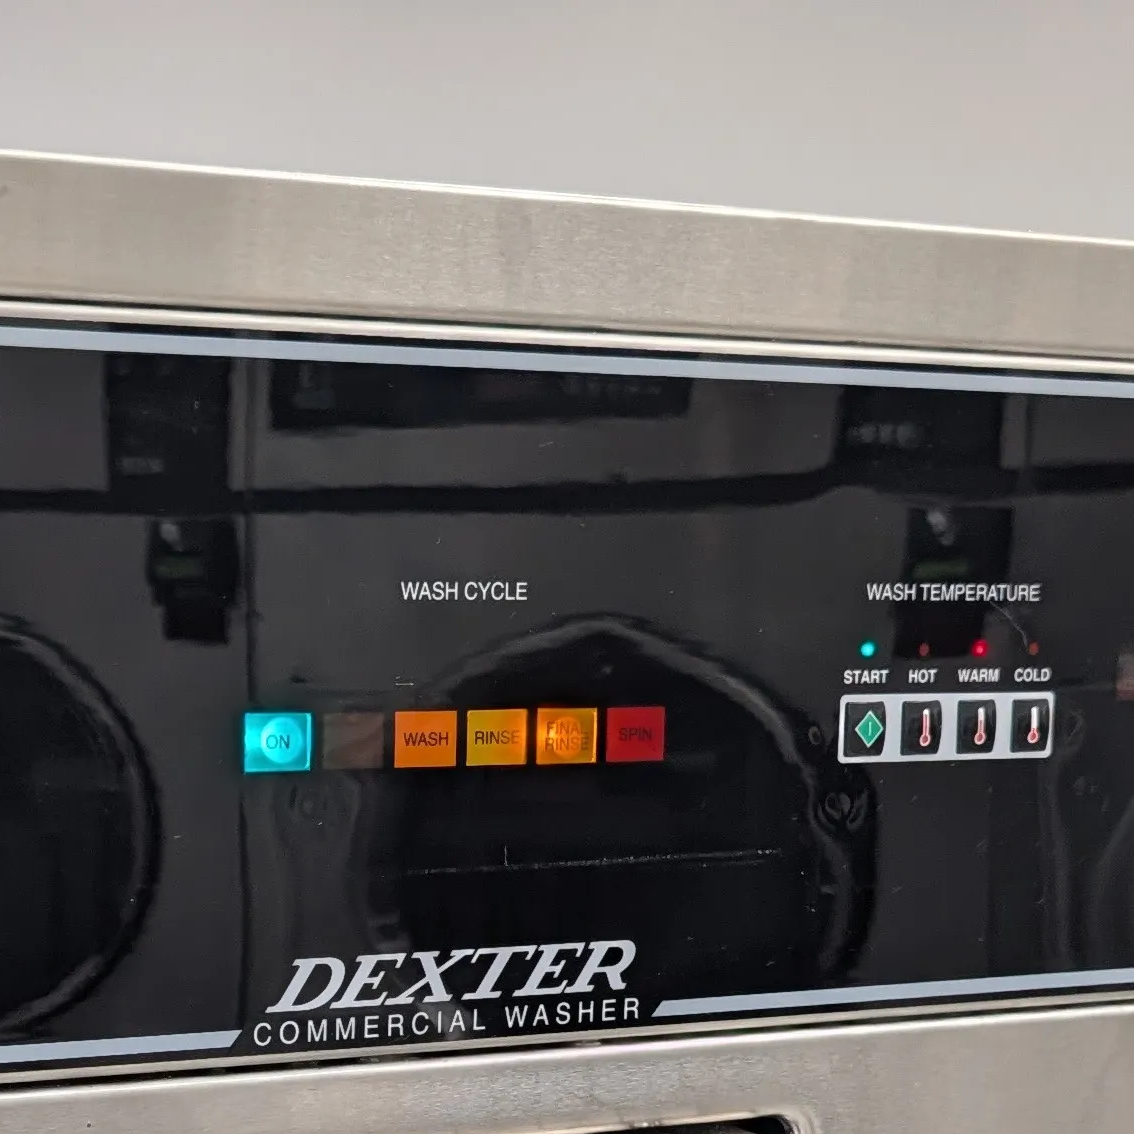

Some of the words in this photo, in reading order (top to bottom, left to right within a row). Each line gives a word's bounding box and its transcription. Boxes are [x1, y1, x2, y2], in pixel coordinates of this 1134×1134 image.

[400, 581, 458, 601] WASH
[464, 581, 528, 601] CYCLE
[866, 583, 916, 601] WASH
[920, 583, 1041, 602] TEMPERATURE
[843, 669, 889, 685] START
[908, 669, 938, 684] HOT
[958, 668, 1000, 683] WARM
[1014, 668, 1052, 682] COLD
[266, 734, 290, 750] ON
[403, 731, 449, 748] WASH
[474, 729, 519, 746] RINSE
[618, 727, 652, 741] SPIN
[265, 939, 637, 1014] DEXTER
[253, 1008, 486, 1047] COMMERCIAL
[506, 997, 640, 1029] WASHER
